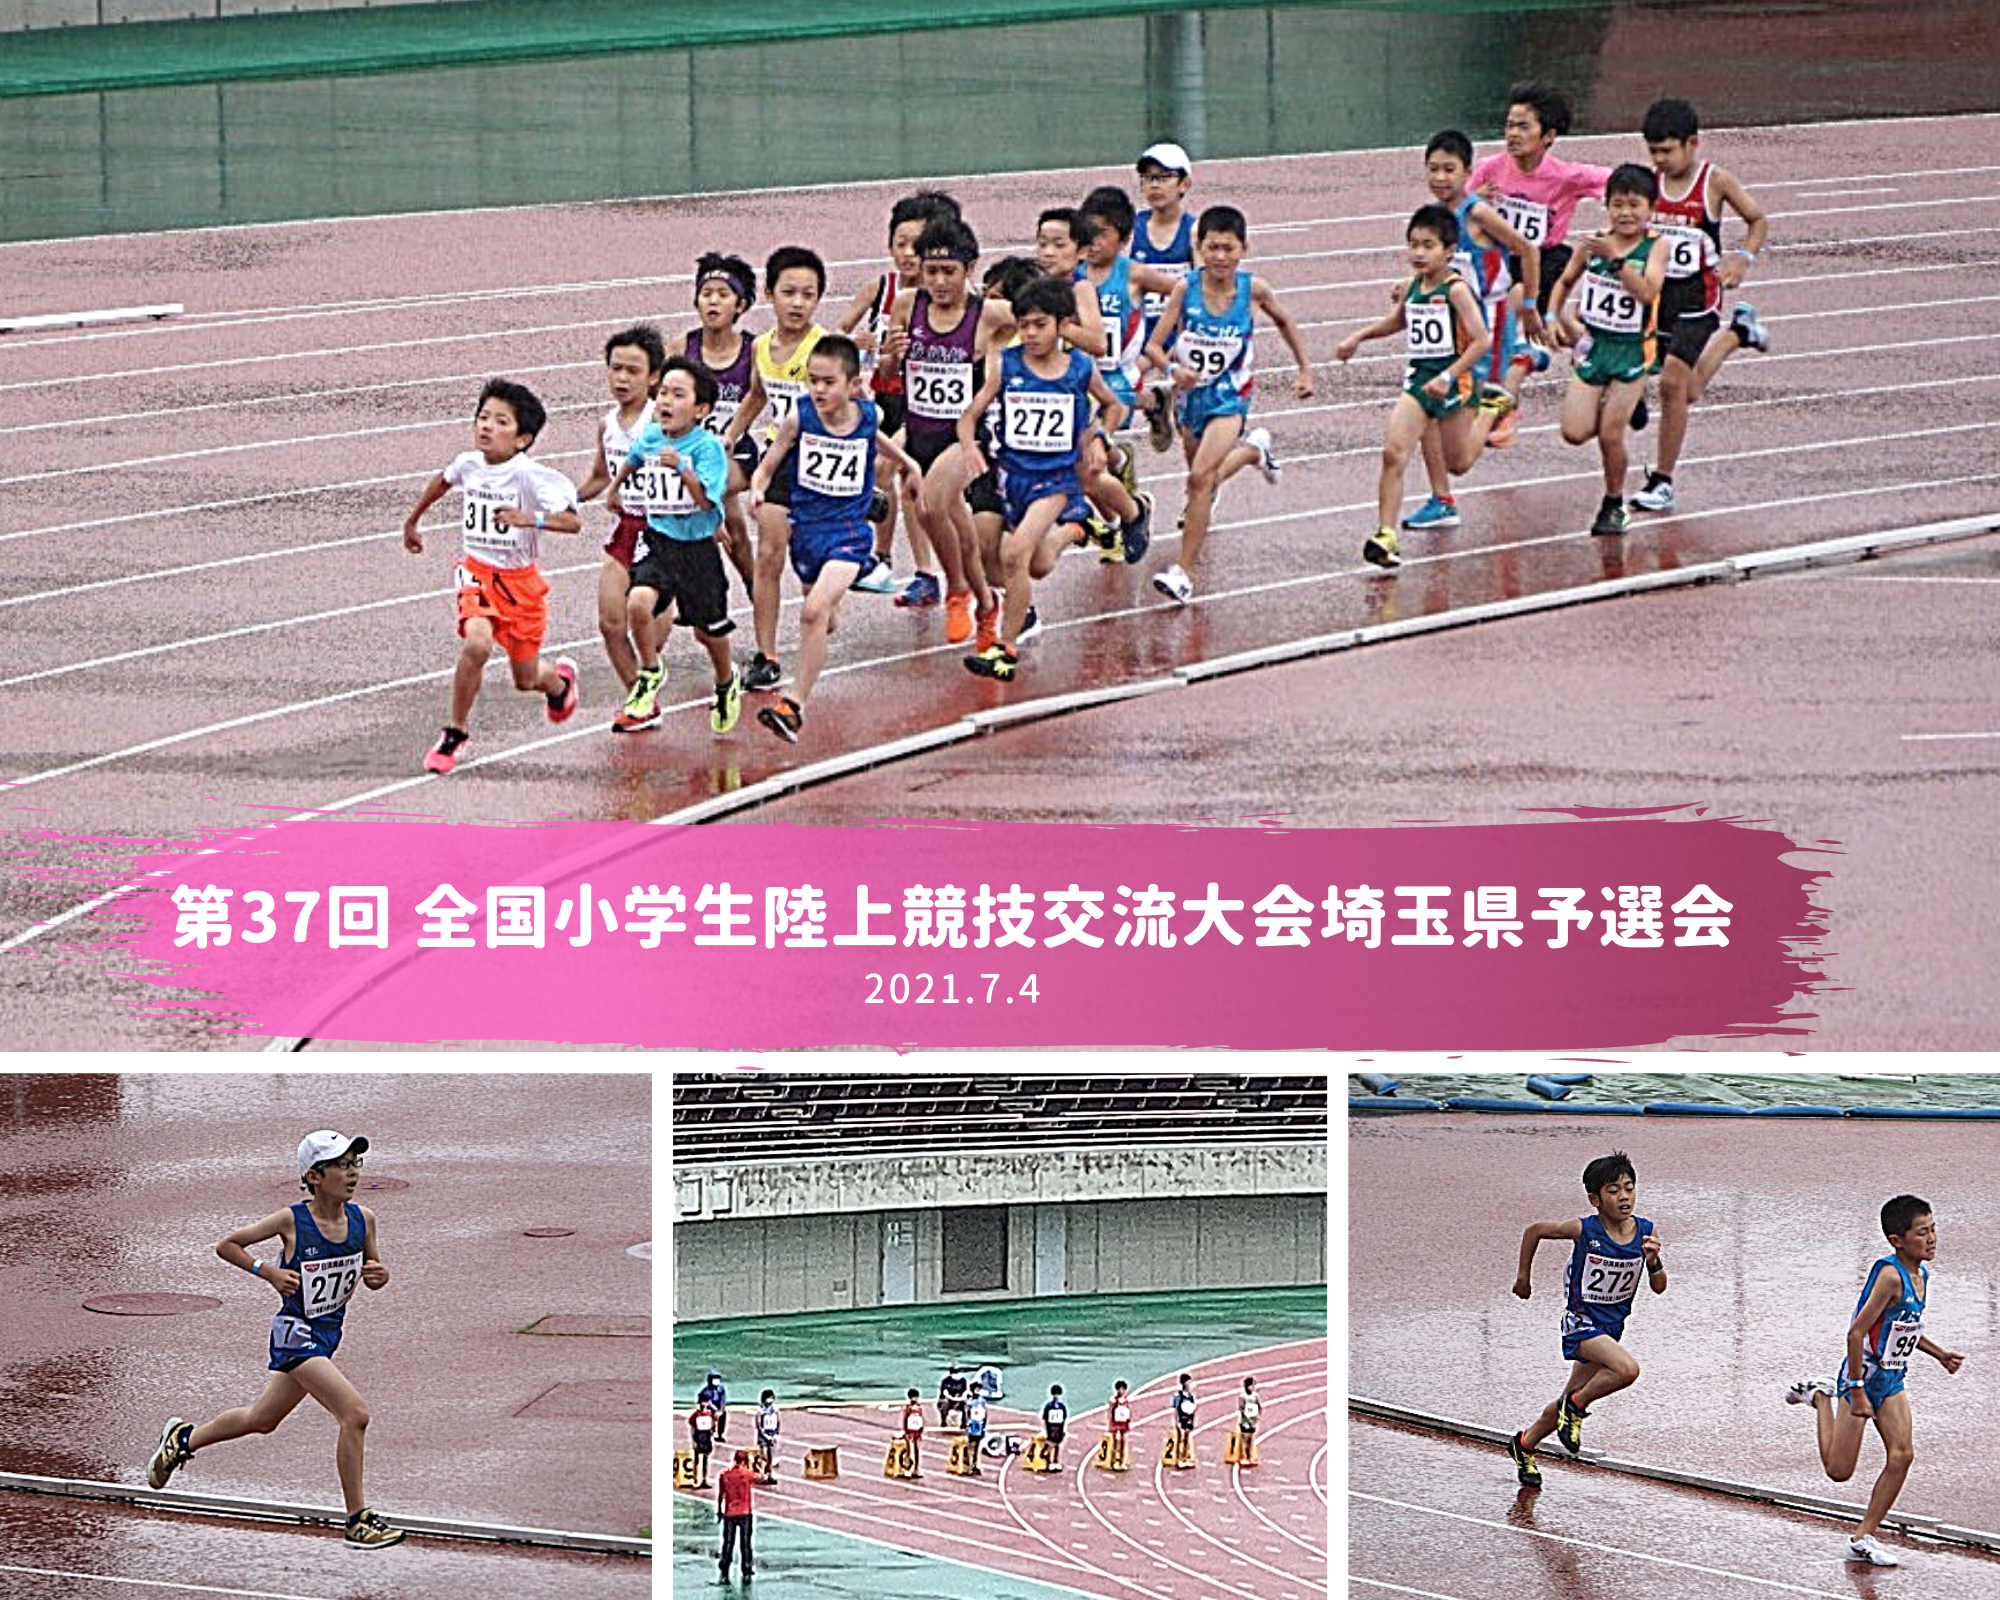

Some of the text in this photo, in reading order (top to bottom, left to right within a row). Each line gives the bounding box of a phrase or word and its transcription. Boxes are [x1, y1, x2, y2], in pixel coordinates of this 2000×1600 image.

[1585, 287, 1637, 320] 149
[1411, 318, 1444, 345] 50
[1188, 349, 1226, 375] 99
[913, 375, 965, 405] 263
[1013, 408, 1065, 438] 272
[805, 450, 859, 482] 274
[647, 472, 685, 501] 317
[310, 1268, 357, 1305] 273
[1586, 1267, 1635, 1294] 272
[283, 1319, 296, 1345] 7
[1891, 1334, 1918, 1358] 99
[1164, 1437, 1174, 1459] 2
